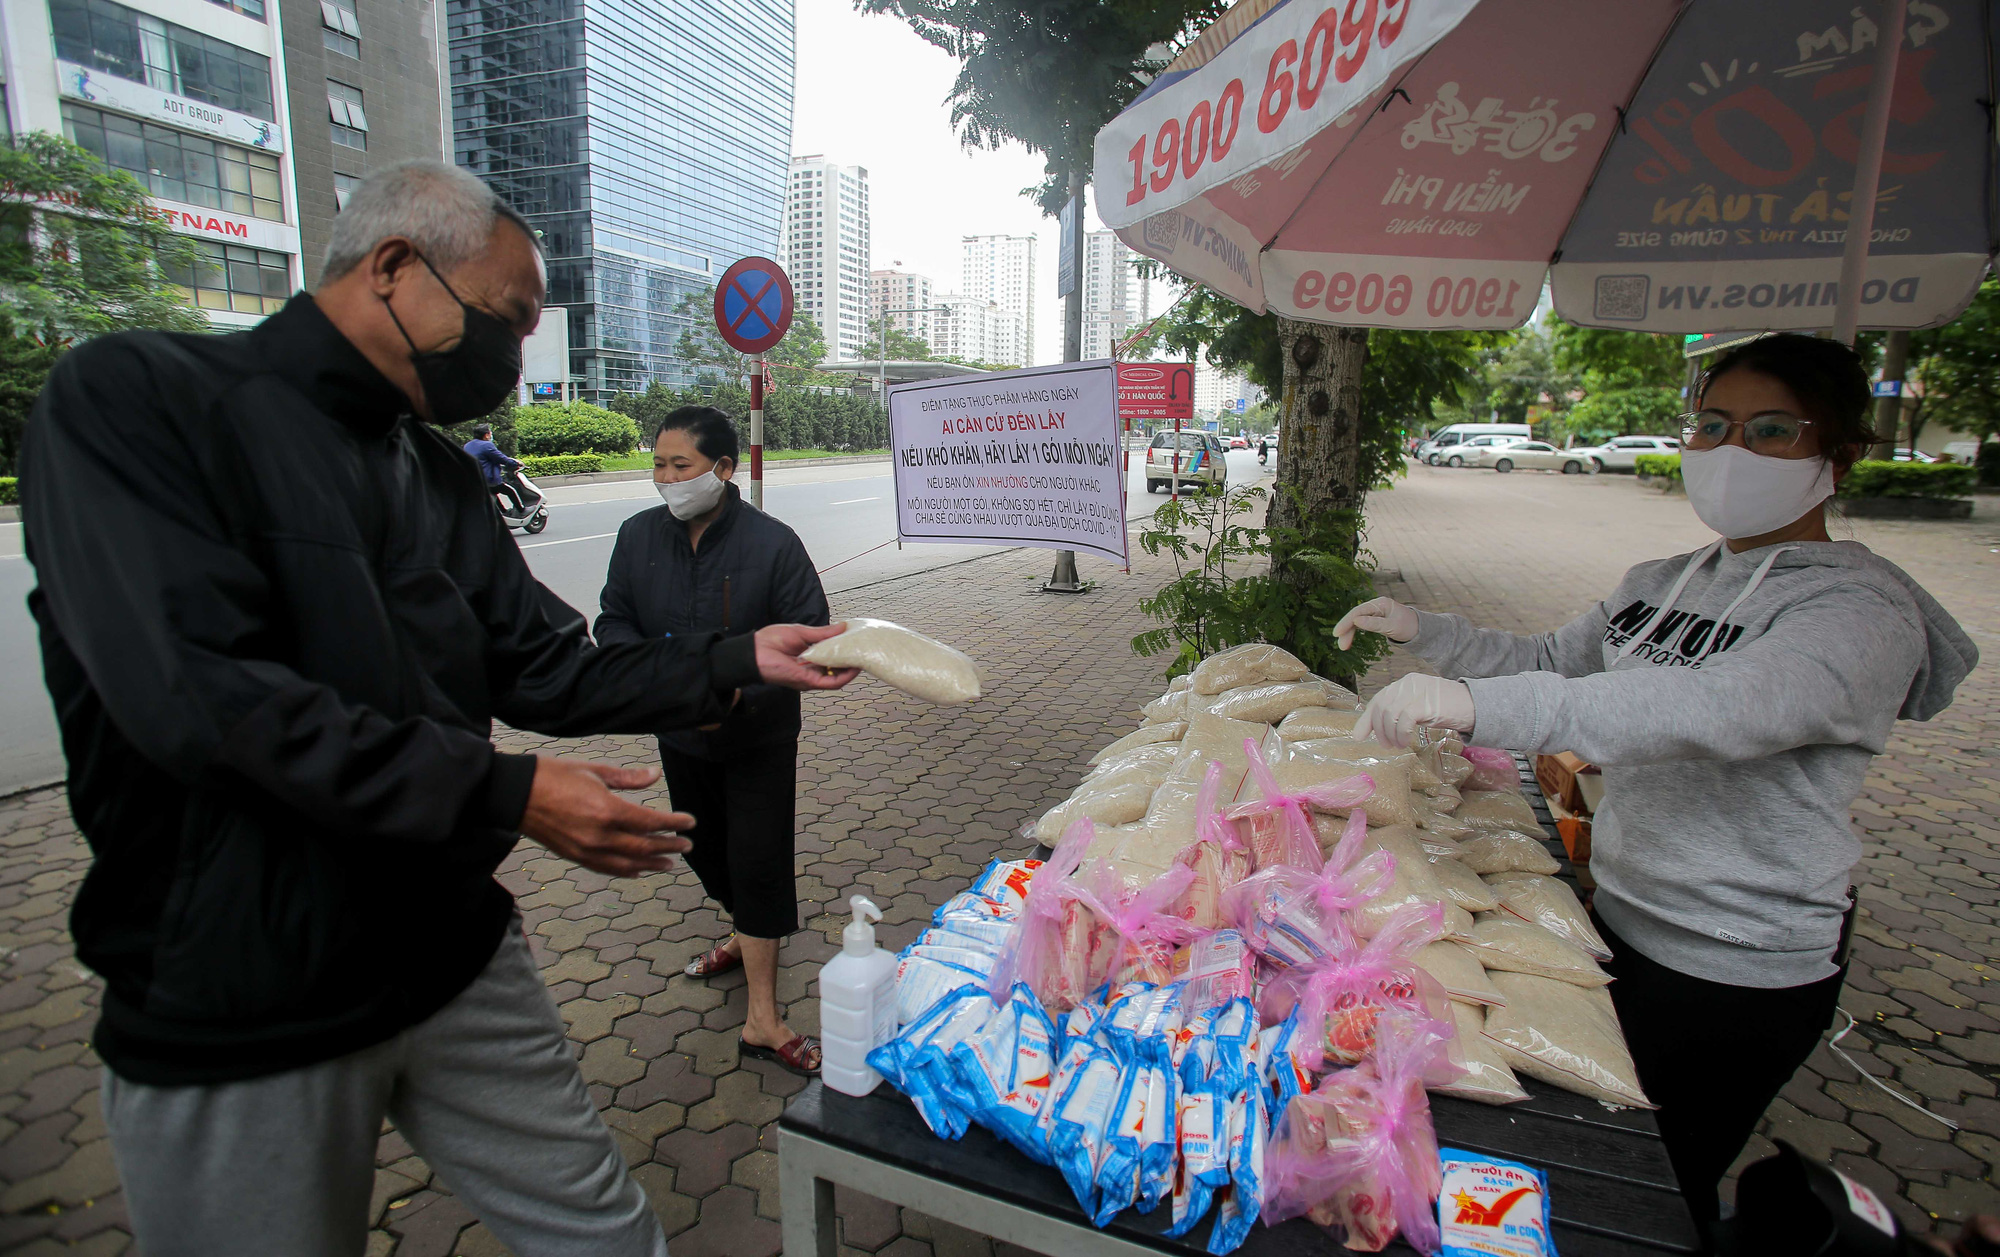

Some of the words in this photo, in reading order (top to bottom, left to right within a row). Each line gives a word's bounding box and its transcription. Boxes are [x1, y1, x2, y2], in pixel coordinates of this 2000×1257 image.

[163, 98, 185, 116] ADT
[188, 106, 224, 126] GROUP
[1125, 78, 1244, 207] 1900
[1021, 388, 1049, 403] HÀNG
[1051, 386, 1079, 401] NGÀY
[1132, 391, 1146, 400] HÀN
[1147, 390, 1166, 400] QUỐC
[942, 419, 954, 434] AI
[956, 414, 983, 433] CẦN
[985, 412, 1004, 432] CỨ
[1008, 410, 1036, 431] ĐẾN
[1038, 409, 1065, 430] LẤY
[901, 444, 923, 467] NẾU
[925, 442, 948, 466] KHÓ
[950, 440, 984, 468] KHĂN,
[984, 439, 1006, 464] HÃY
[1008, 438, 1030, 464] LẤY
[1033, 443, 1040, 463] 1
[1041, 437, 1063, 464] GÓI
[1064, 437, 1087, 465] MỖI
[1087, 437, 1114, 468] NGÀY
[945, 477, 961, 490] BẠN
[976, 476, 989, 488] XIN
[1029, 476, 1048, 489] CHO
[1049, 474, 1080, 491] NGƯỜI
[1080, 476, 1101, 493] KHÁC
[991, 496, 1022, 511] KHÔNG
[1023, 498, 1035, 513] SỢ
[916, 512, 935, 524] CHIA
[948, 510, 971, 525] CÙNG
[973, 513, 996, 525] NHAU
[1025, 514, 1044, 527] QUA
[1045, 515, 1059, 530] ĐẠI
[1060, 517, 1081, 531] DỊCH
[1082, 519, 1105, 535] COVID
[1109, 525, 1117, 539] 19
[1473, 1186, 1502, 1194] ASEAN
[1483, 1176, 1514, 1188] SẠCH
